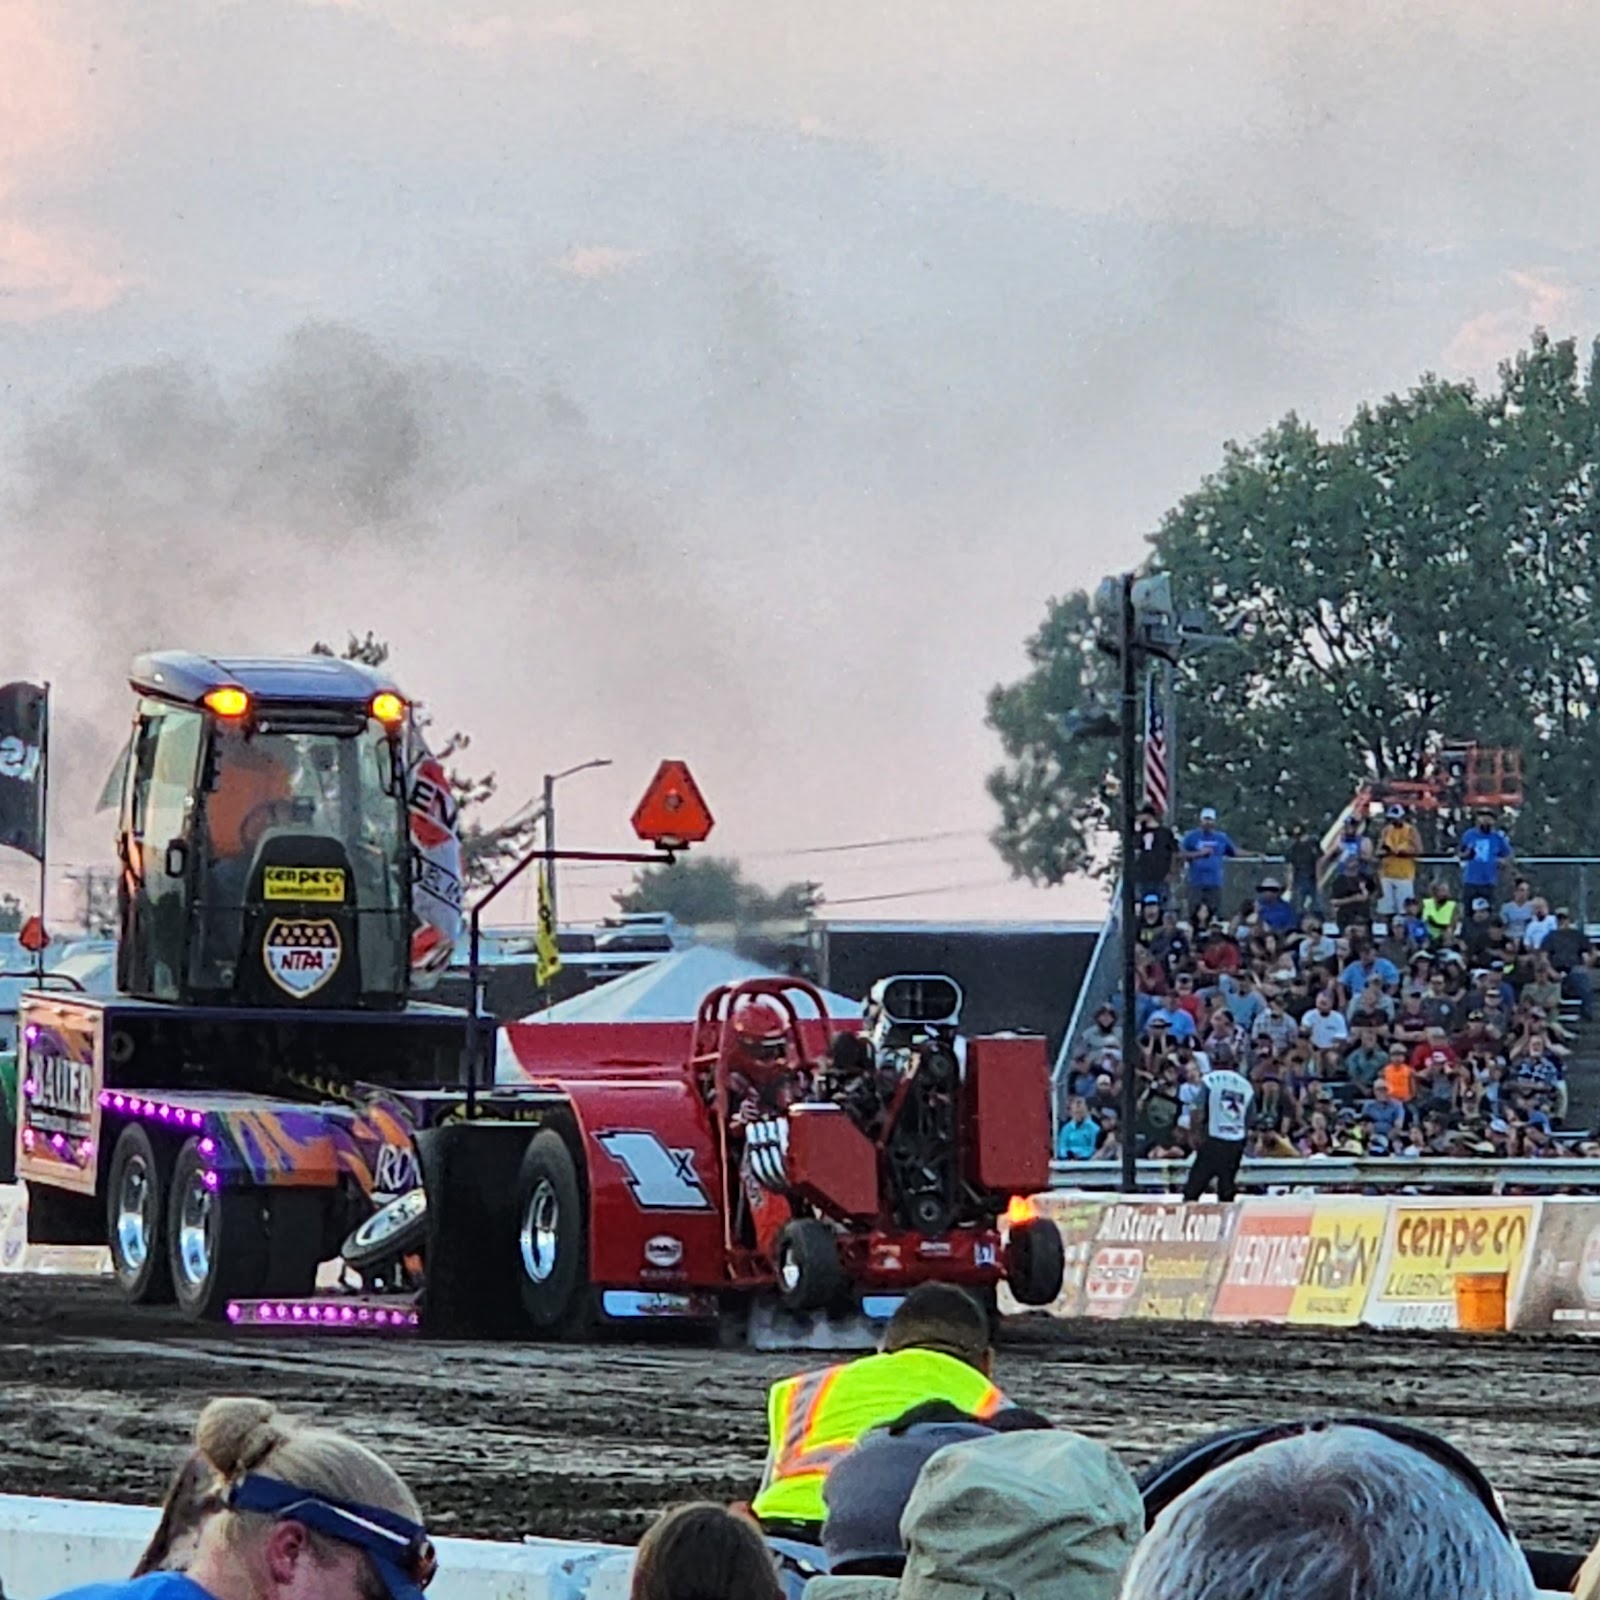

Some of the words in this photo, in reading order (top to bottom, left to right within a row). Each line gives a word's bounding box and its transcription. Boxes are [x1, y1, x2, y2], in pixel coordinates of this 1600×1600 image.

[281, 950, 323, 969] NTPA
[1096, 1204, 1222, 1242] AllStarPull.com
[1227, 1236, 1311, 1286] HERITAGE
